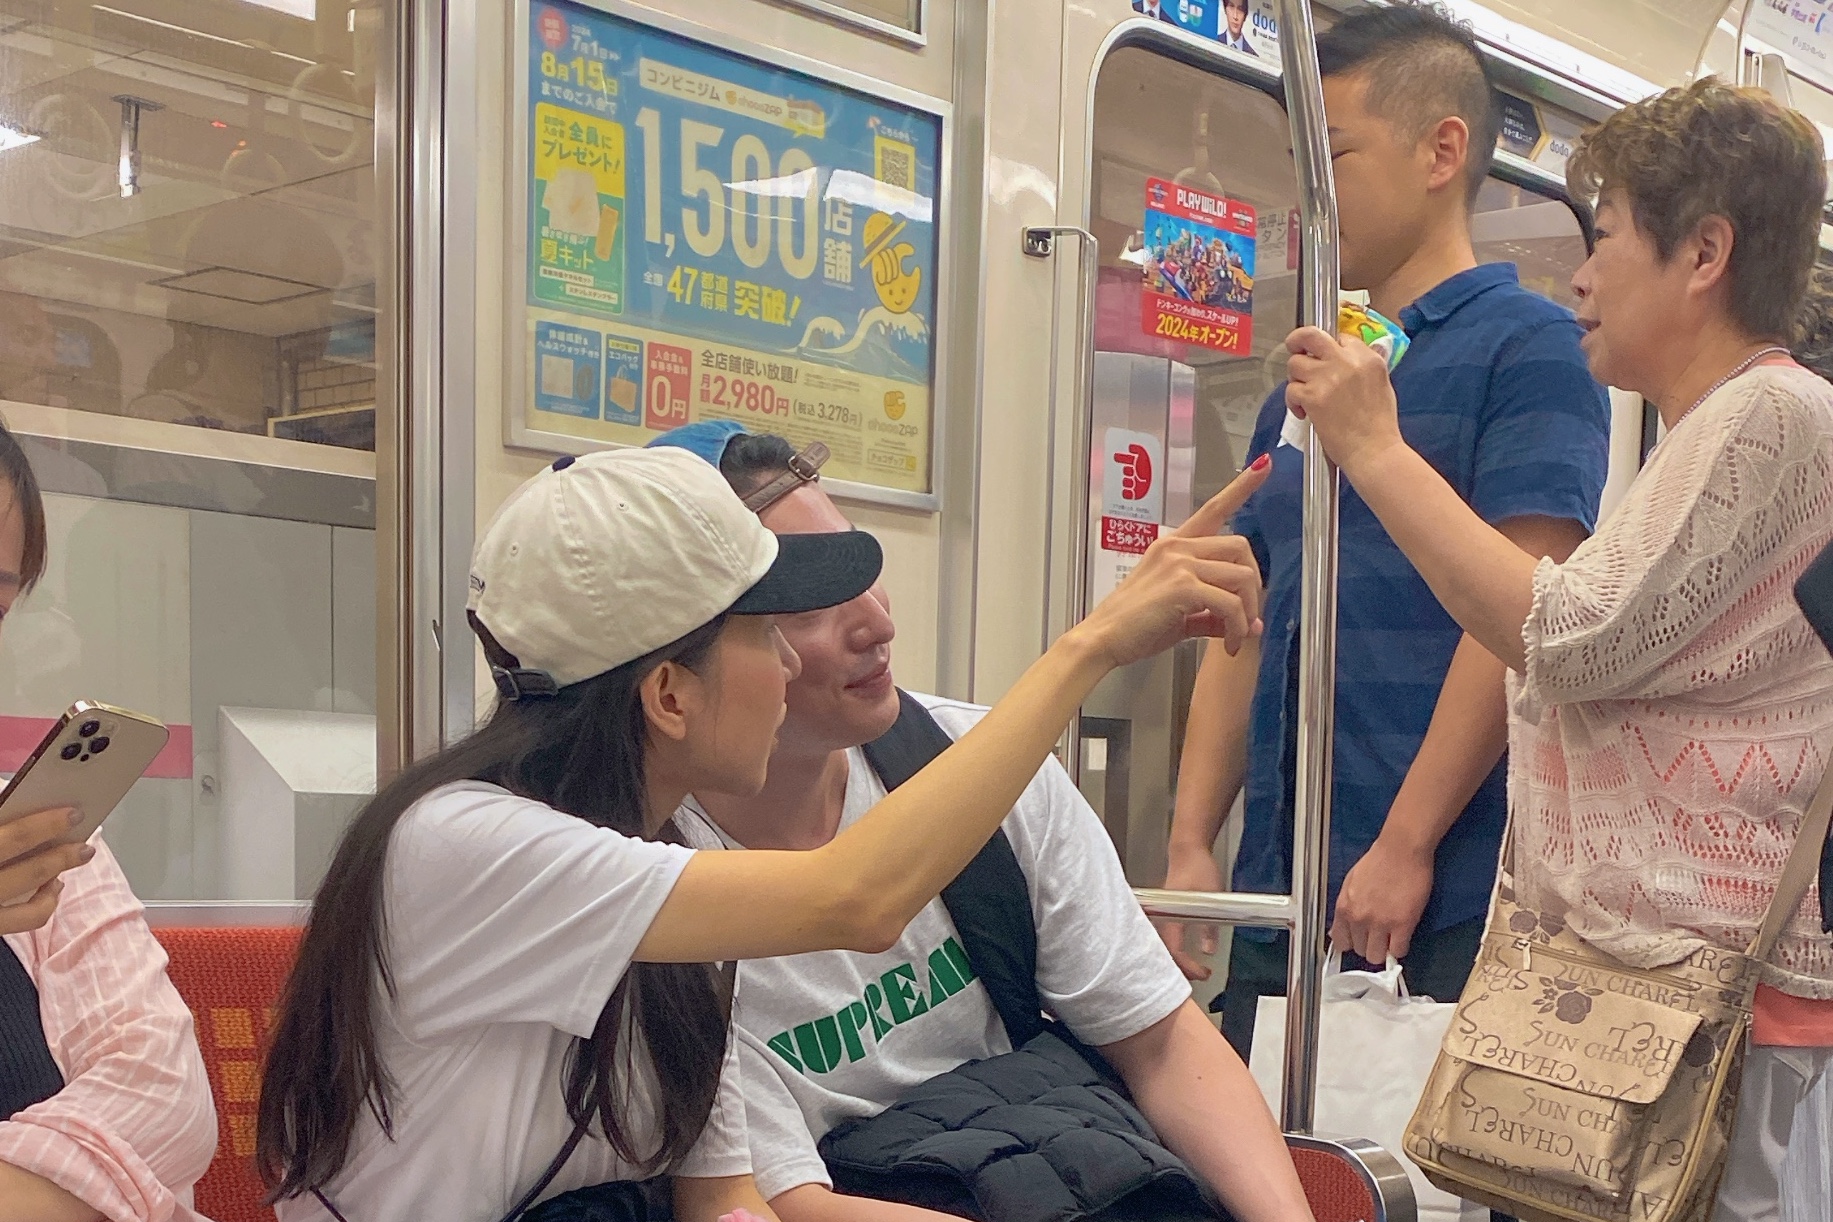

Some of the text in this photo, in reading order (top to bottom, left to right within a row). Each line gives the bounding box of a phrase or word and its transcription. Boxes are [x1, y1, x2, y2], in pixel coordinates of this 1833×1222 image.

[541, 51, 618, 96] 8月15日
[647, 69, 720, 101] コンビニジム
[634, 107, 819, 279] 1,500
[667, 265, 699, 305] 47
[701, 349, 798, 384] 全店舗使い放題!
[651, 375, 686, 419] 0円
[712, 375, 790, 418] 2,980円
[1524, 1021, 1579, 1051] SUN
[1519, 1087, 1570, 1120] SUN
[1463, 1106, 1574, 1157] CHAREL
